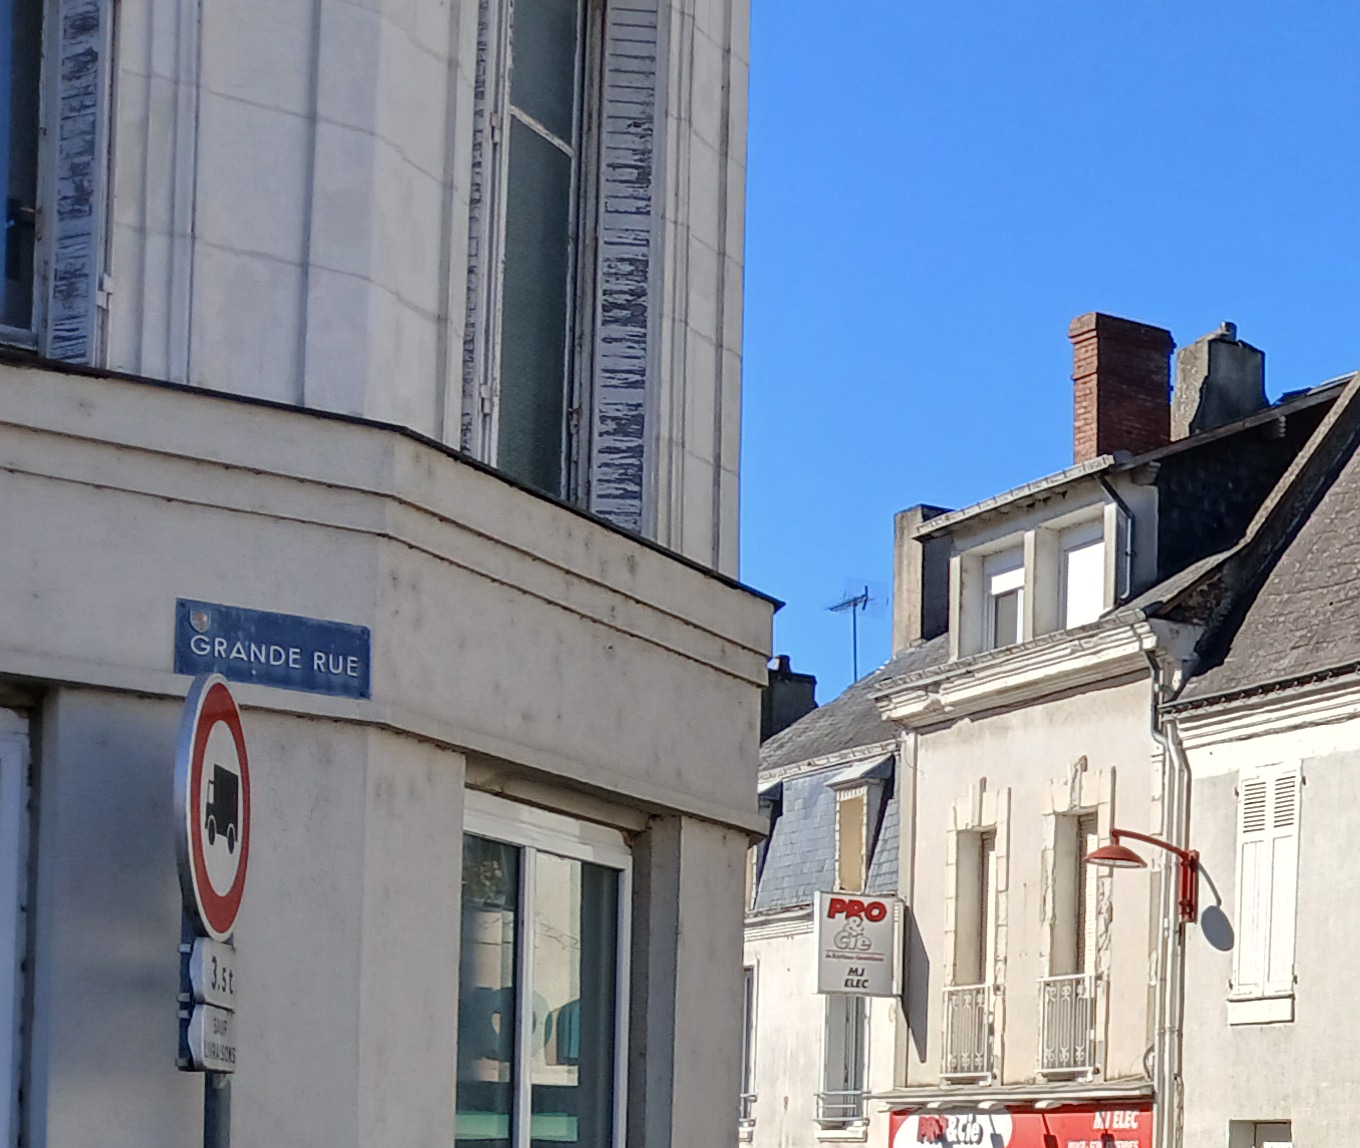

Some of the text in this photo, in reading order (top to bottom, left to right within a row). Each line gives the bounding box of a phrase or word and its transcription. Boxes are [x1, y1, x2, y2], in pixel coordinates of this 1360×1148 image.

[190, 635, 359, 677] GRANDE RUE
[827, 898, 887, 922] PRO
[834, 930, 872, 951] Cie
[848, 967, 865, 977] MJ
[844, 979, 869, 988] ELEC
[1112, 1111, 1139, 1129] ELEC
